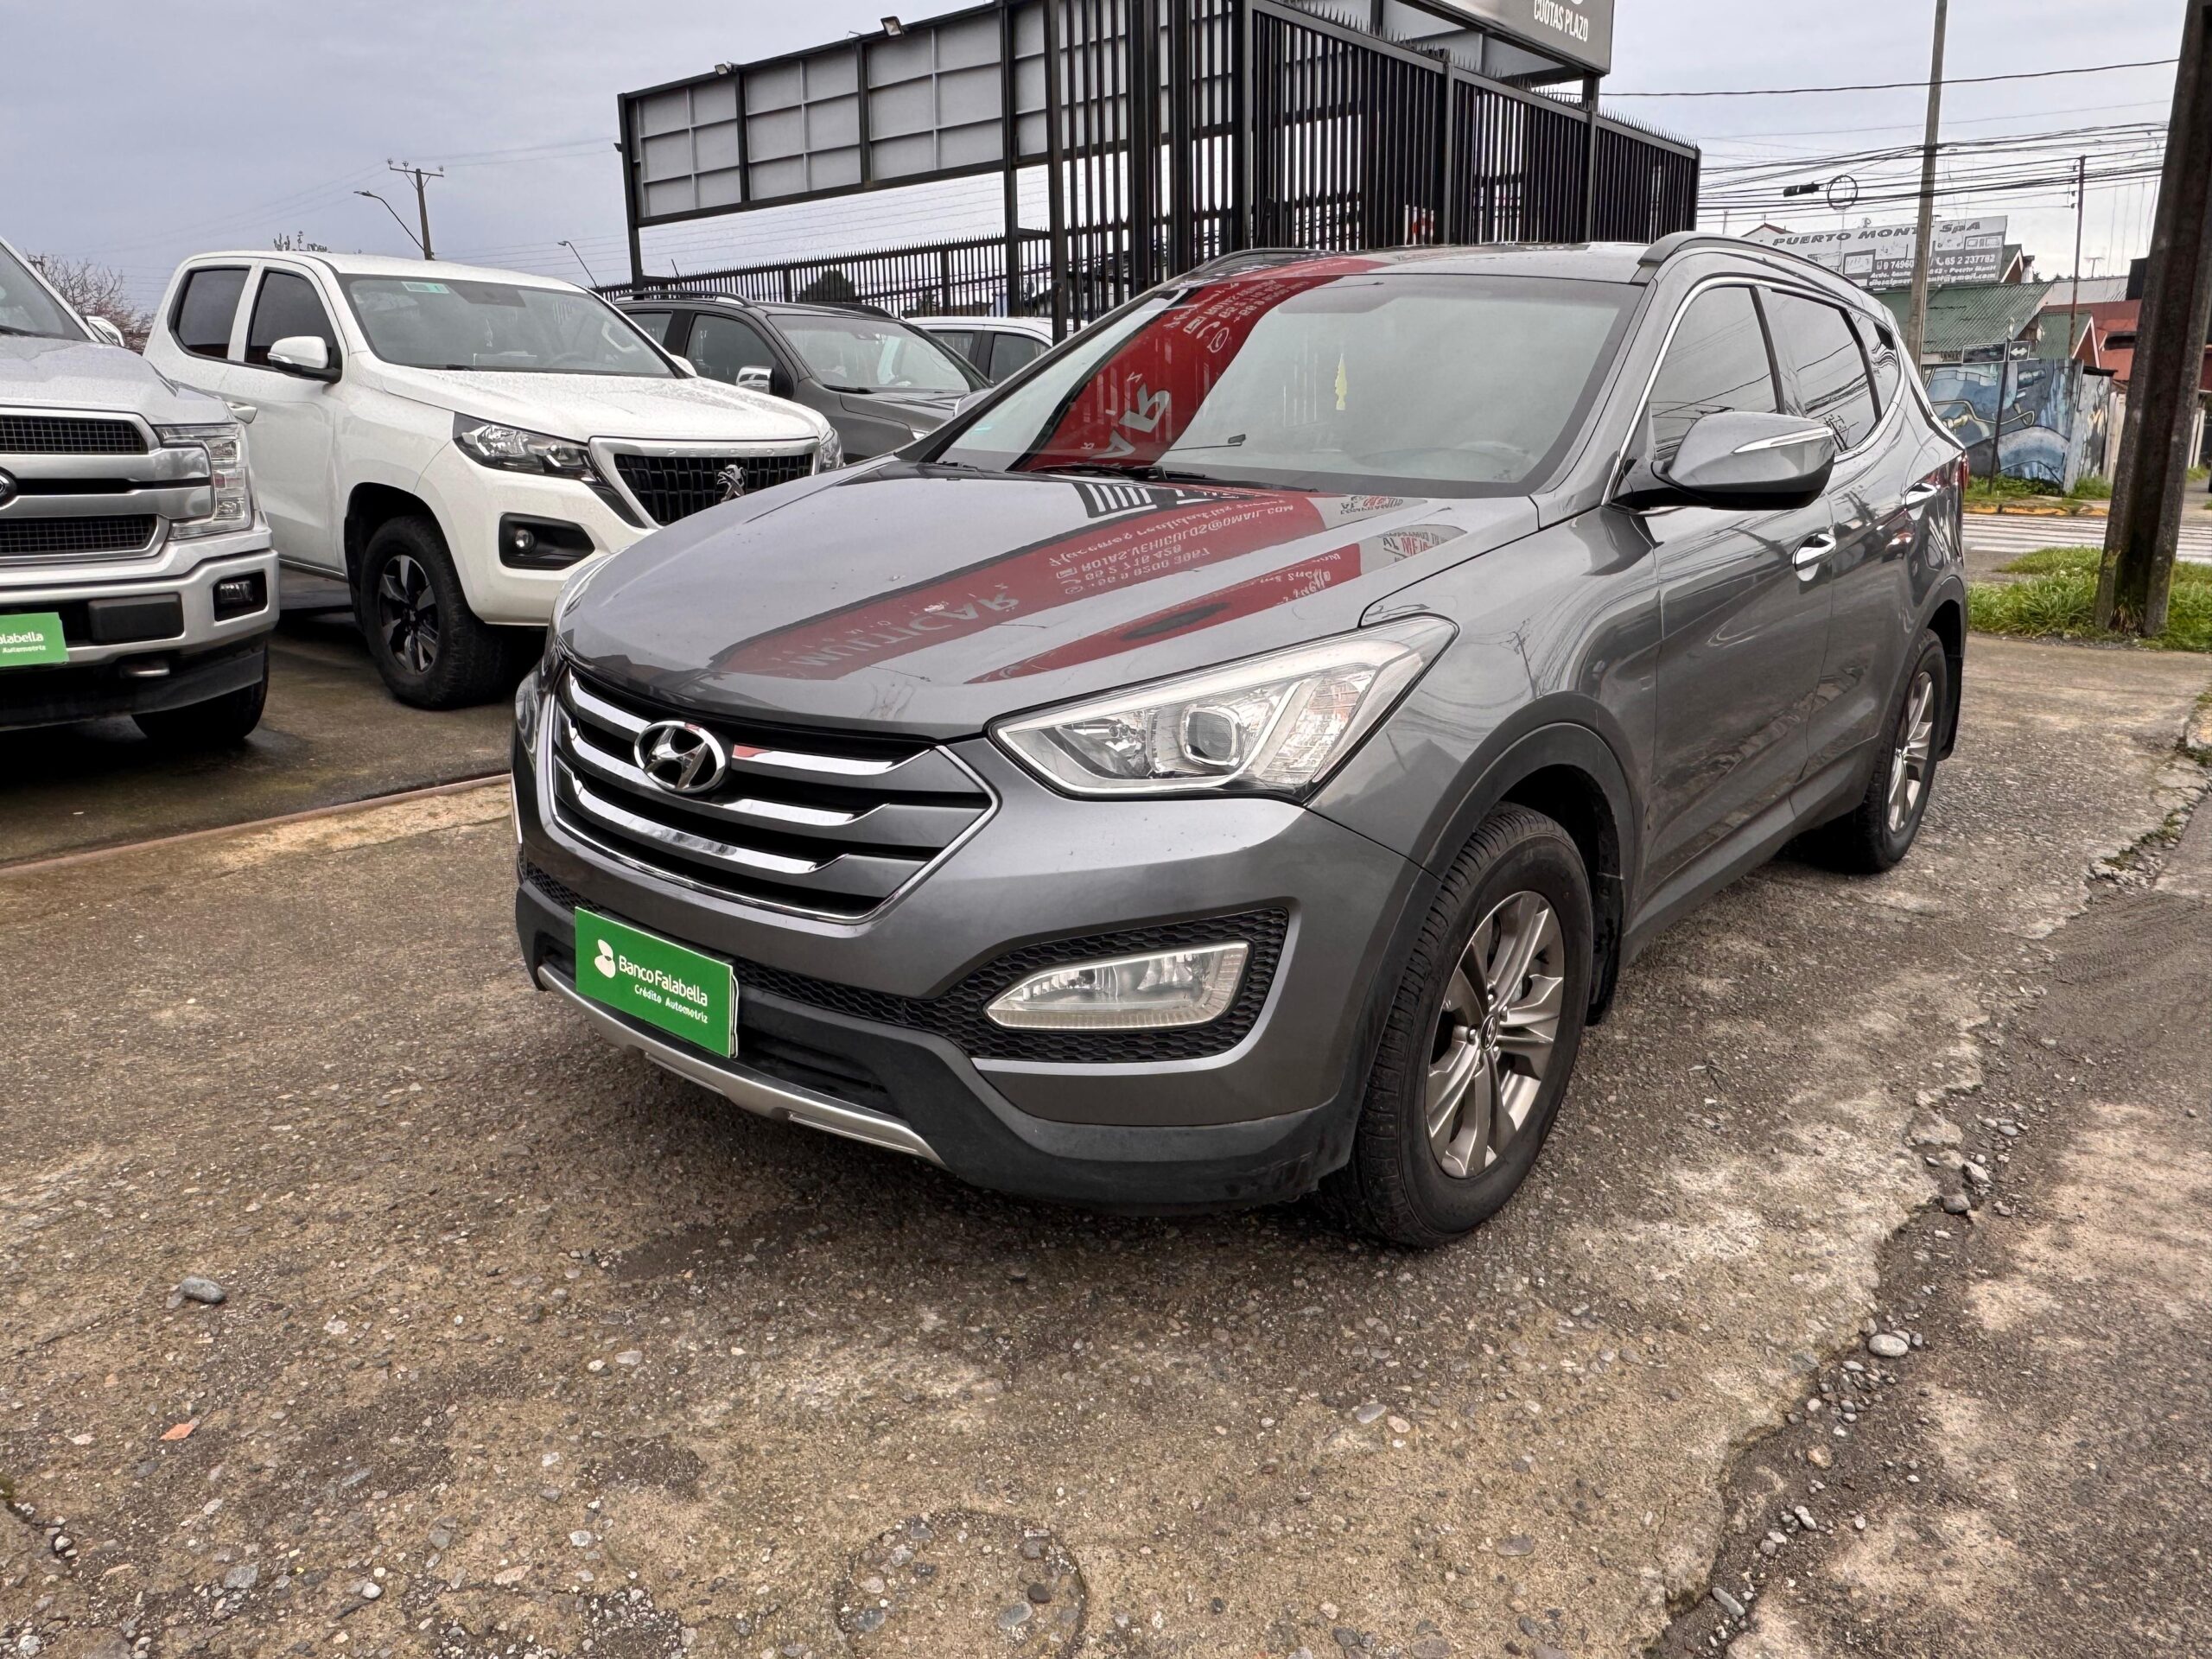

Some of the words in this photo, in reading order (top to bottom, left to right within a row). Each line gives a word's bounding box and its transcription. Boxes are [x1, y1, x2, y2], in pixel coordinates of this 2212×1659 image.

[1534, 0, 1563, 31] CUOTAS
[1565, 9, 1589, 42] PLAZO
[1772, 232, 1851, 246] PUERTO
